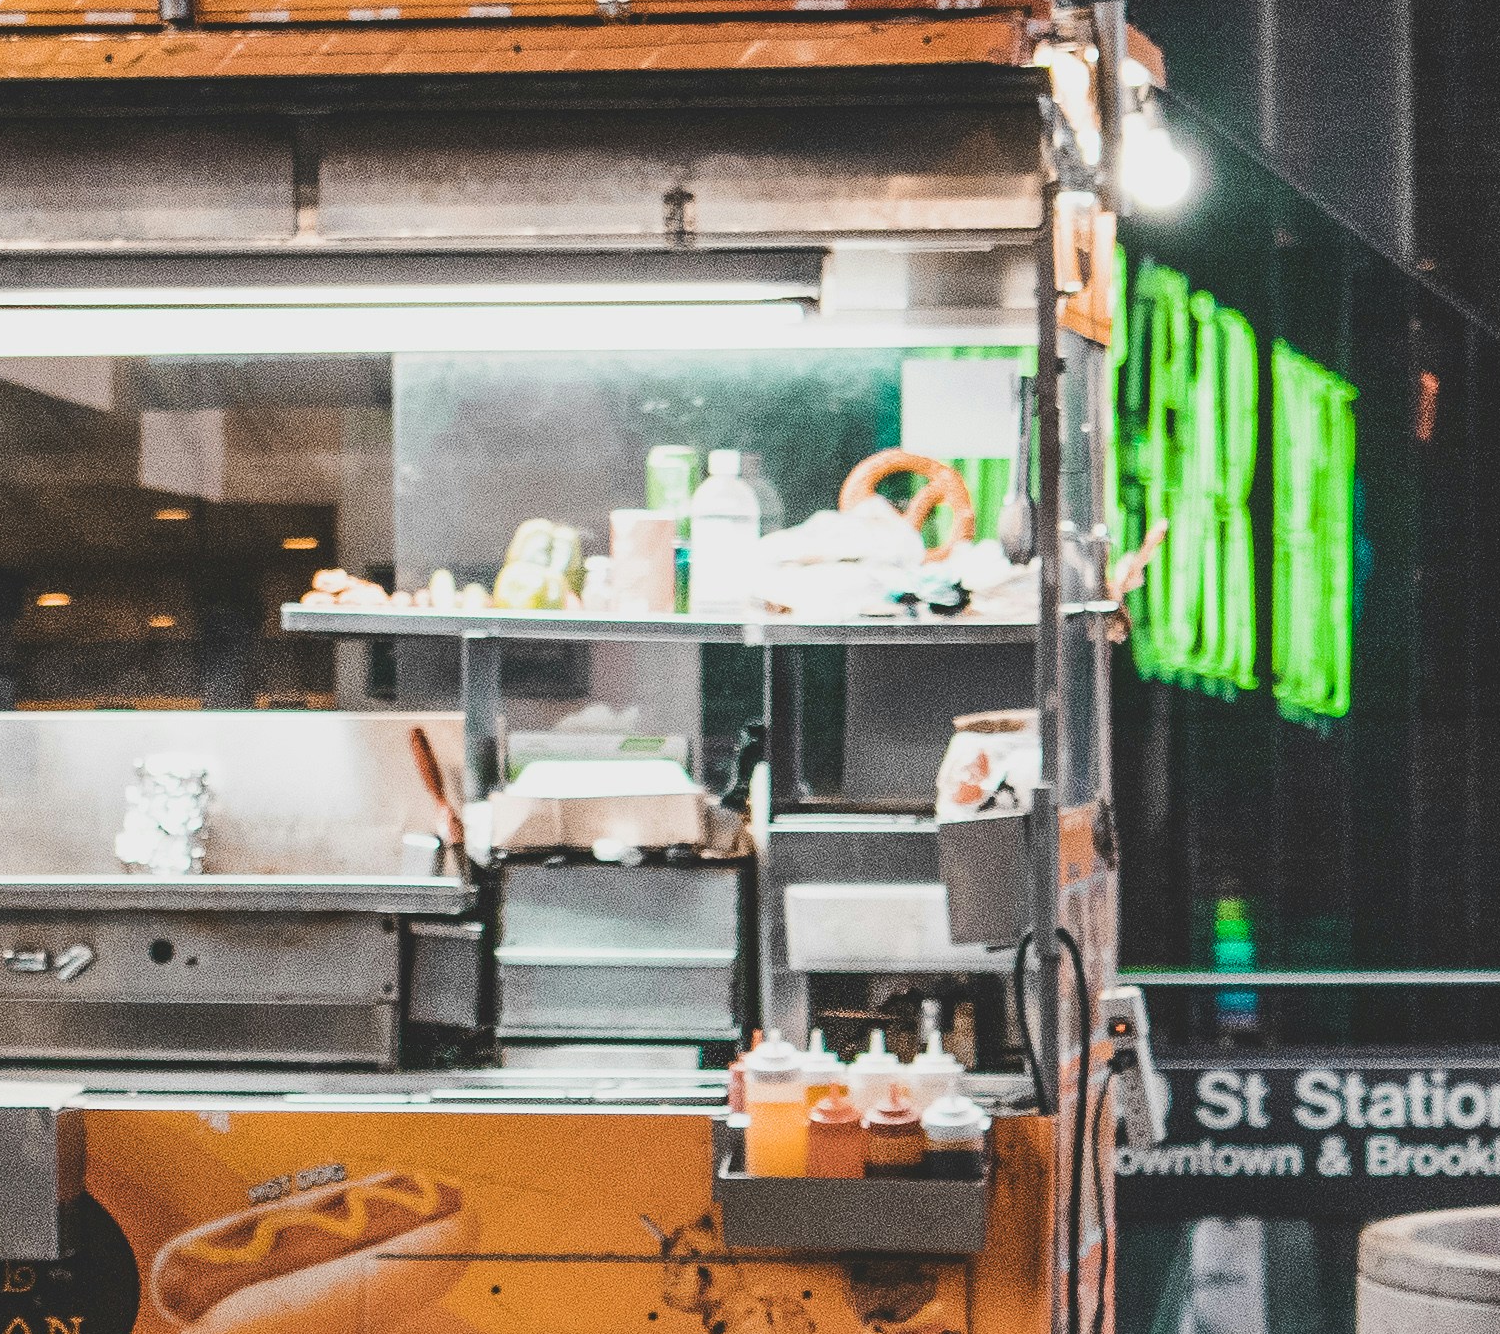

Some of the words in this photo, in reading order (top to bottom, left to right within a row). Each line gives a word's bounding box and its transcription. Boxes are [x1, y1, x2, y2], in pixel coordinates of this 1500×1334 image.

[1195, 1070, 1270, 1131] St
[1112, 1138, 1302, 1179] owntown
[1316, 1136, 1350, 1178] &
